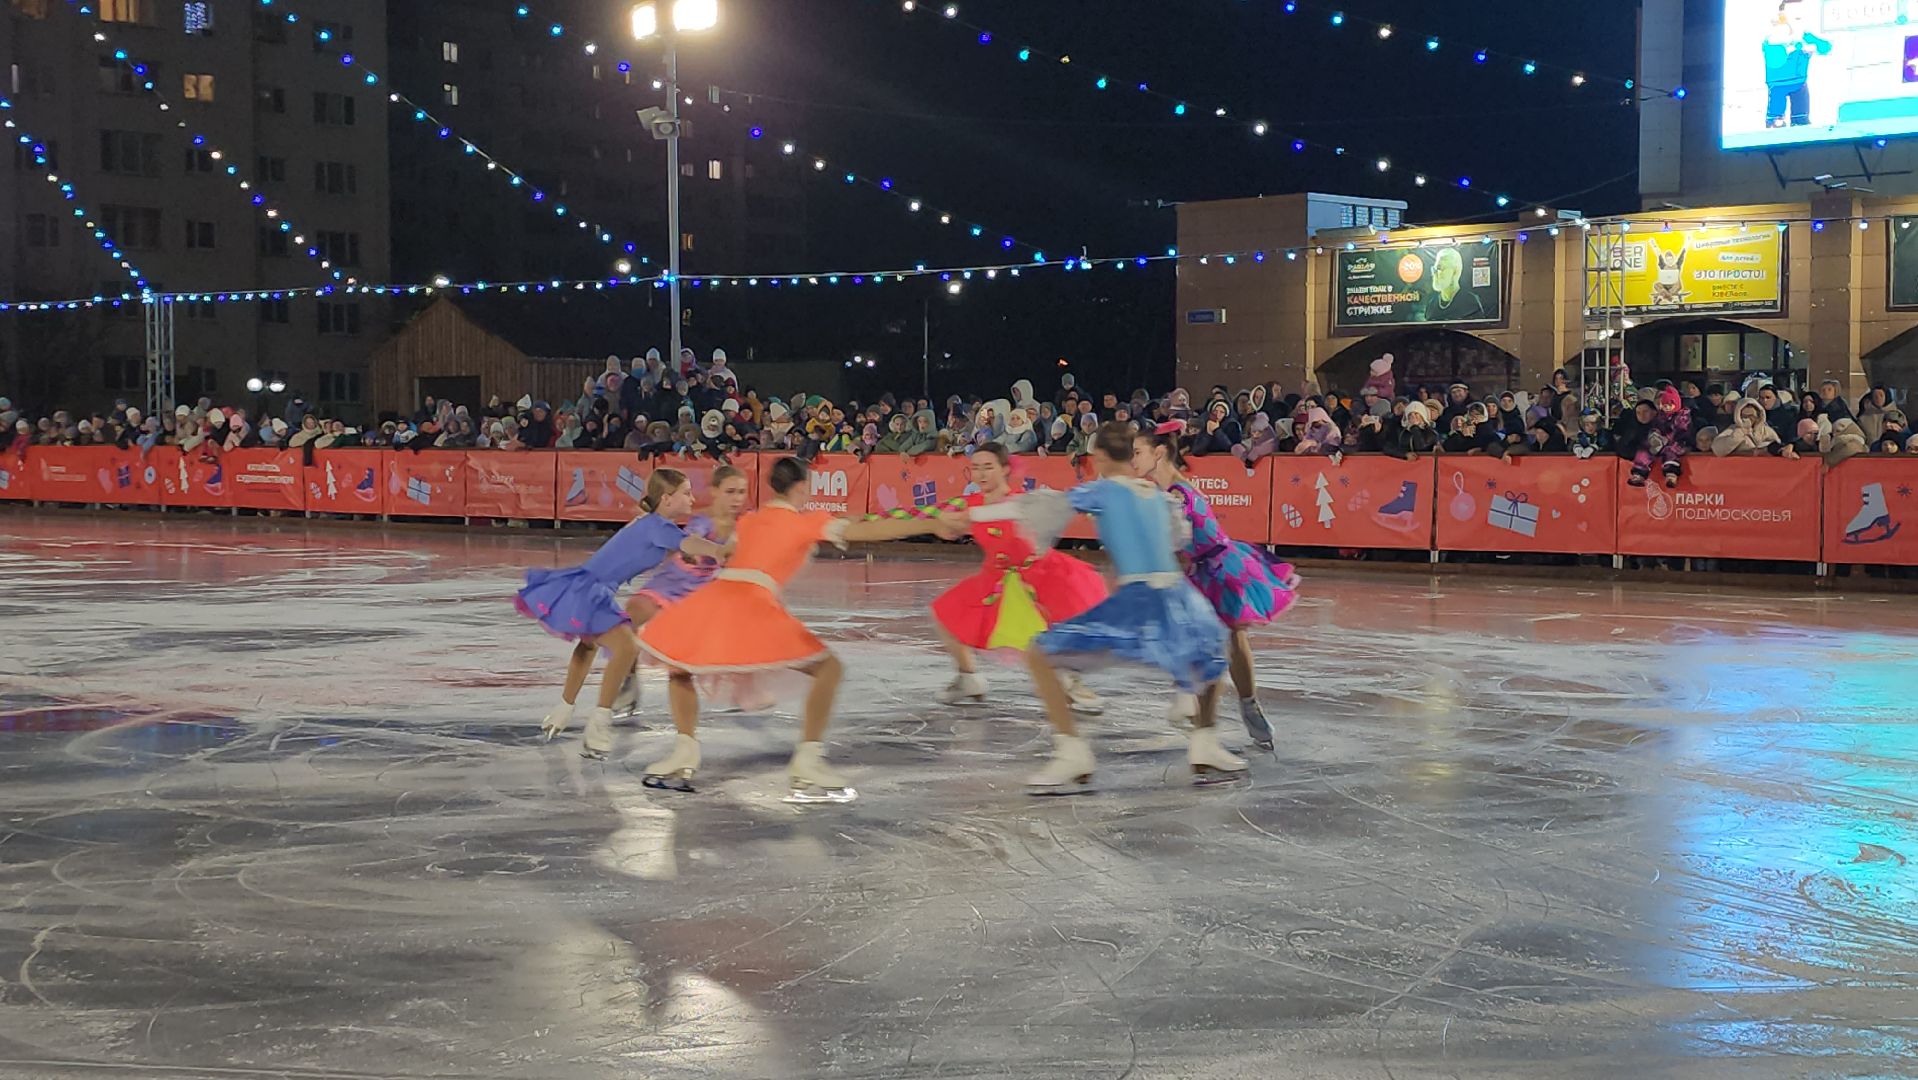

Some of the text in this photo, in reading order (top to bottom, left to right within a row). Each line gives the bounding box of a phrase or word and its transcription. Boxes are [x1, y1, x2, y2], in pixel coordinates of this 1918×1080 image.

[1612, 245, 1644, 258] BER
[1695, 269, 1764, 279] ЭТО ПРОСТО!
[1346, 290, 1420, 304] КАЧЕСТВЕННОЙ
[1346, 304, 1393, 316] СТРИЖКЕ
[811, 470, 848, 497] МА
[1190, 475, 1229, 490] ЙТЕСЬ
[1675, 493, 1724, 505] ПАРКИ
[800, 502, 848, 512] МОСКОВЬЕ
[1675, 507, 1792, 522] ПОДМОСКОВЬЯ
